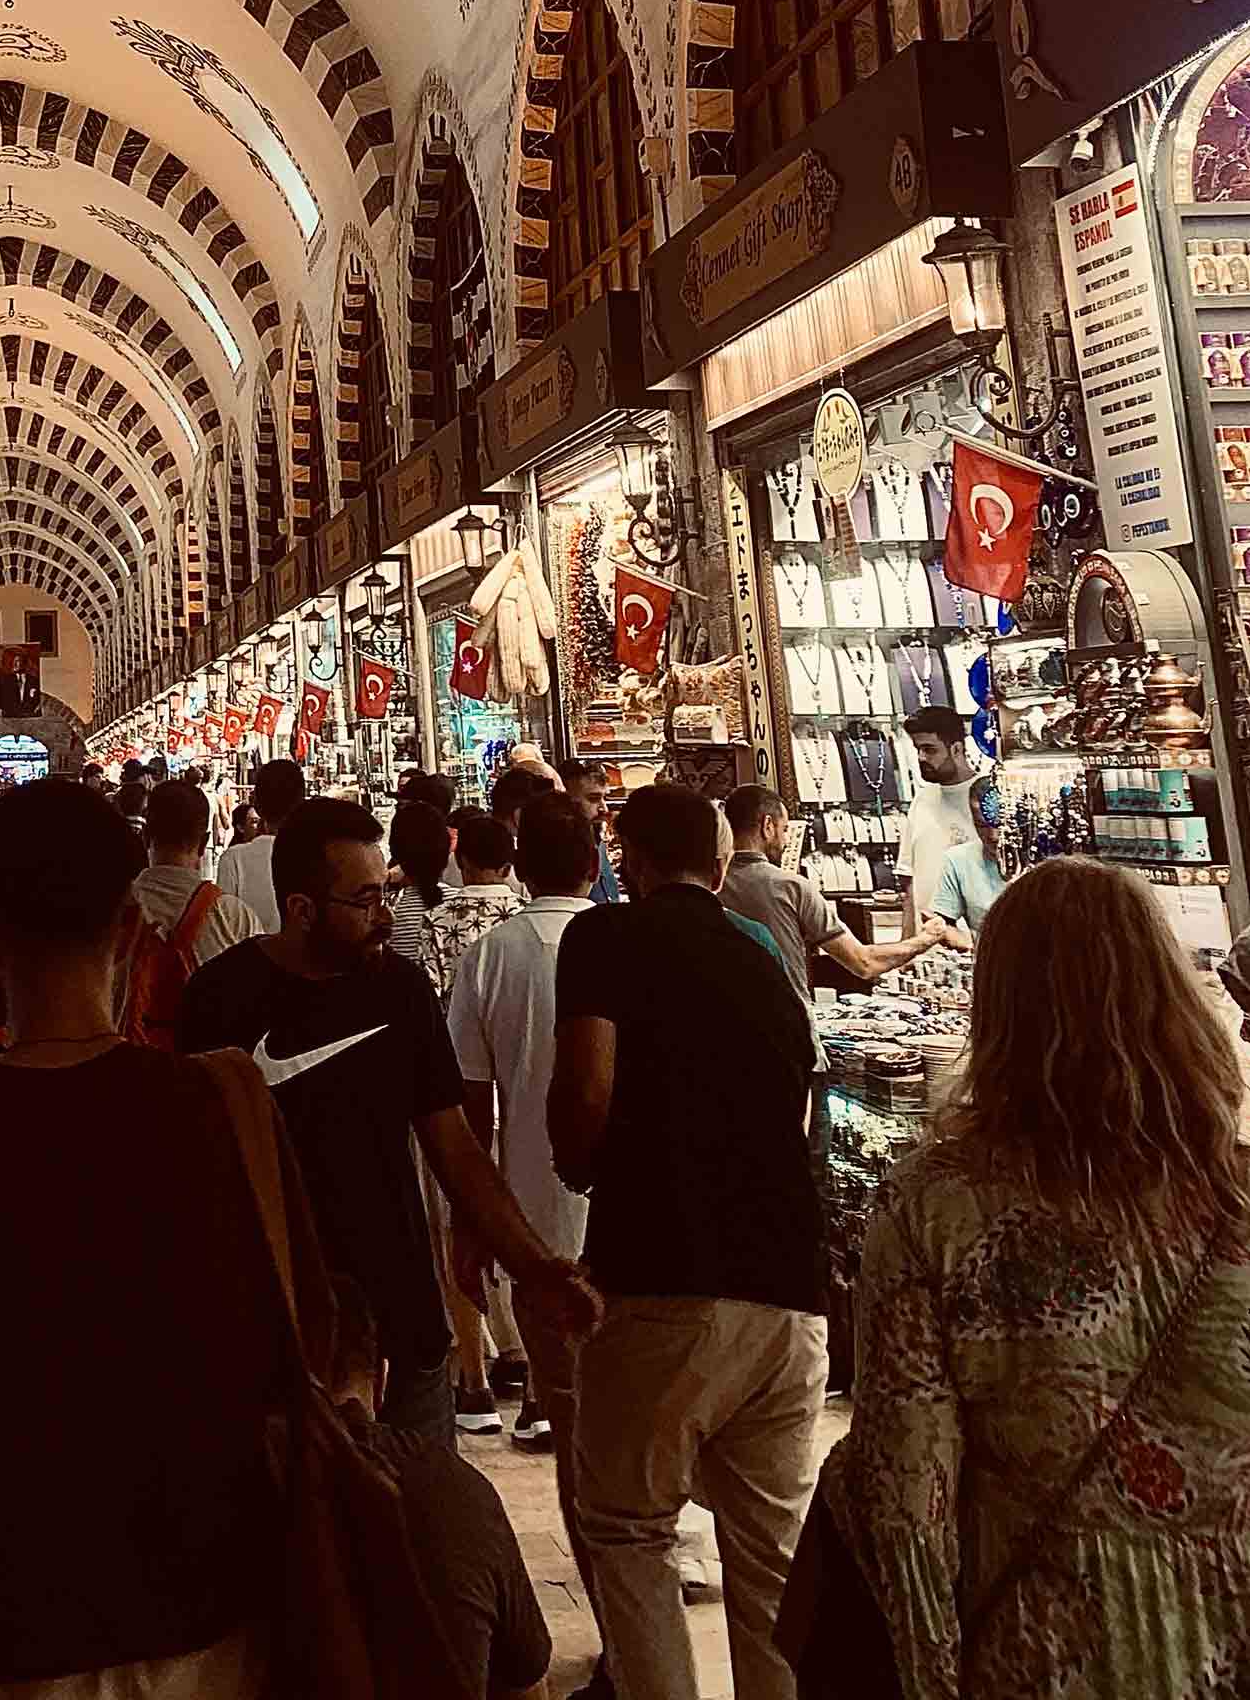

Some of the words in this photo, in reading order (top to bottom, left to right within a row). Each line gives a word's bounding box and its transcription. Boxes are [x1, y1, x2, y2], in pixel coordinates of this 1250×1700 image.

[743, 206, 768, 267] Gift
[772, 190, 804, 242] Shop
[1069, 203, 1081, 226] SE
[1081, 191, 1110, 221] HABLA
